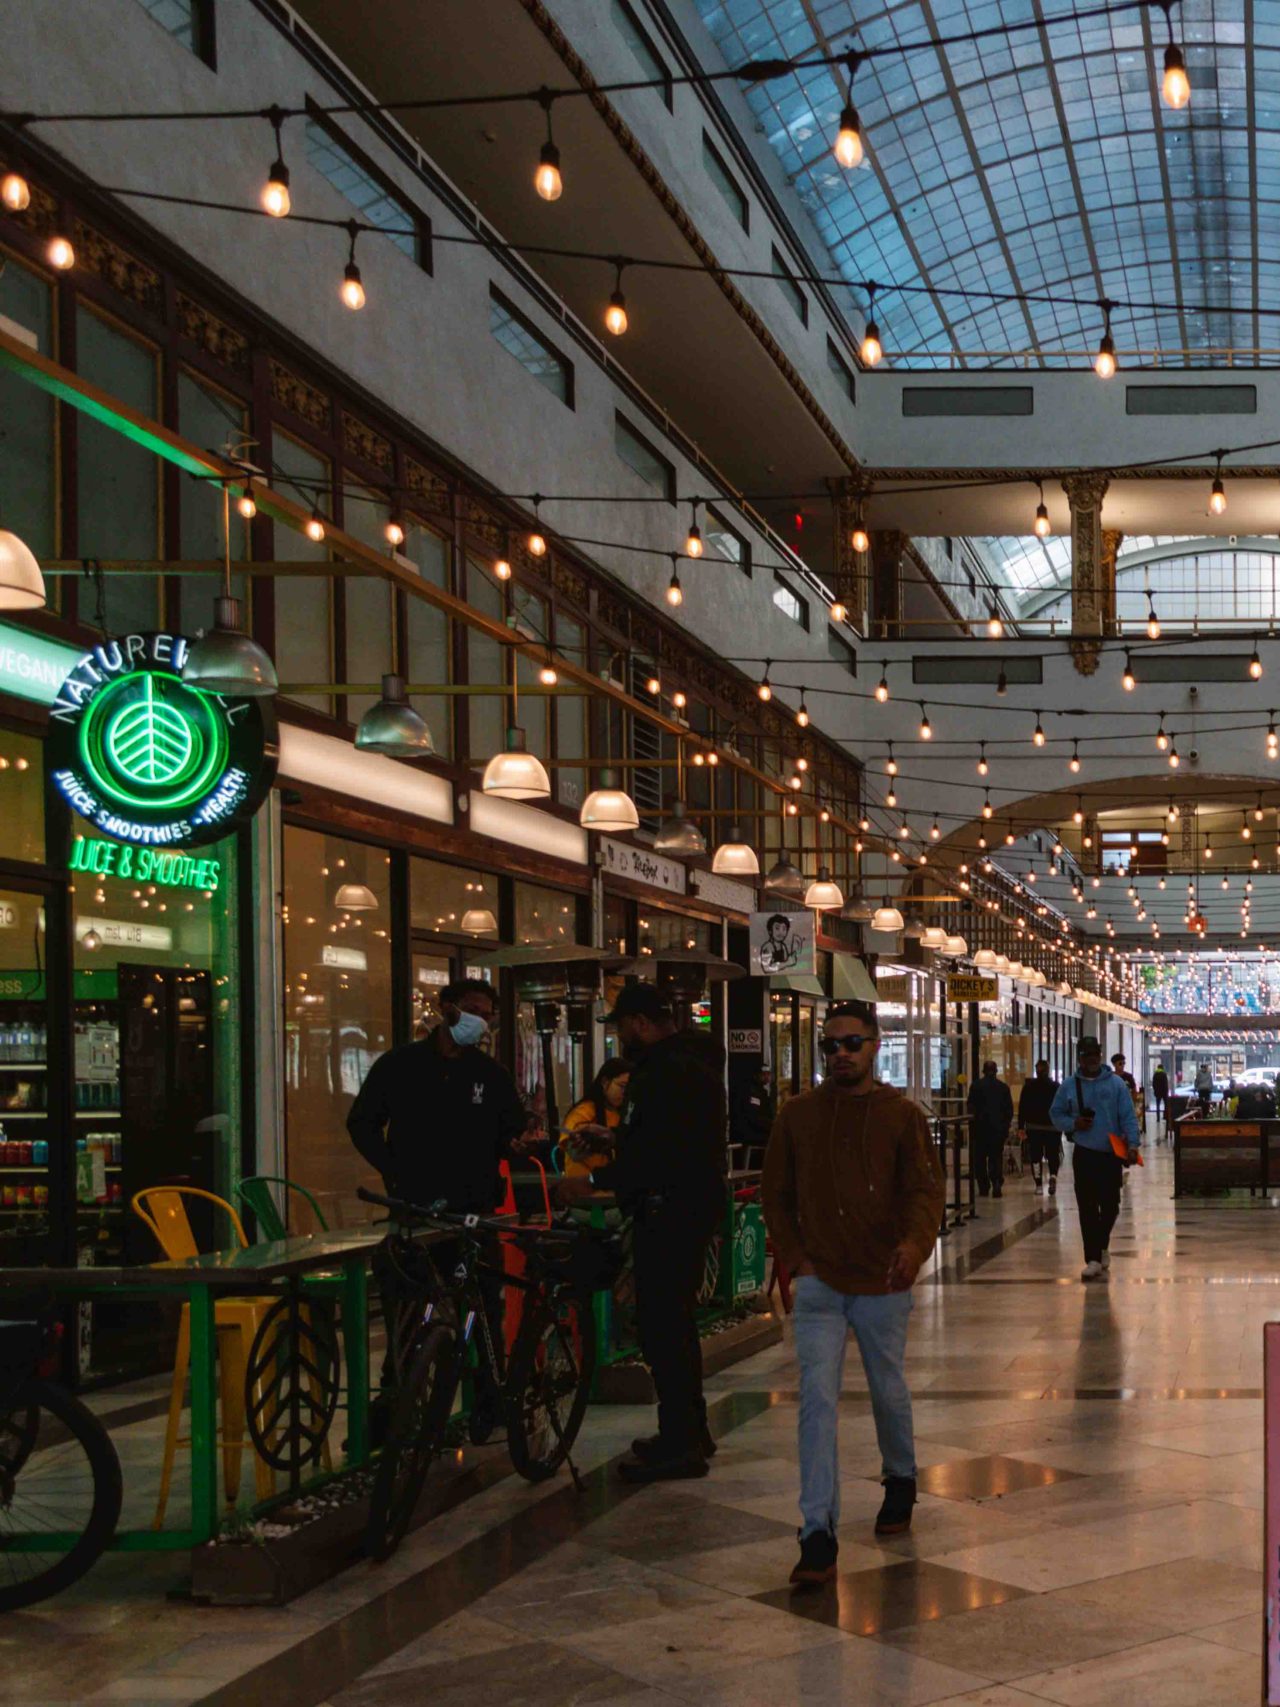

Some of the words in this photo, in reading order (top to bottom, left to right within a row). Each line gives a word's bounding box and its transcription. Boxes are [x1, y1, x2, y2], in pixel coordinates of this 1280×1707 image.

[54, 768, 97, 815] JUICE
[96, 808, 192, 845] SMOOTHIES
[201, 766, 247, 822] HEALTH
[69, 838, 118, 876] JUICE
[119, 845, 134, 879] &
[730, 1031, 745, 1043] NO
[730, 1043, 761, 1051] SMOKING
